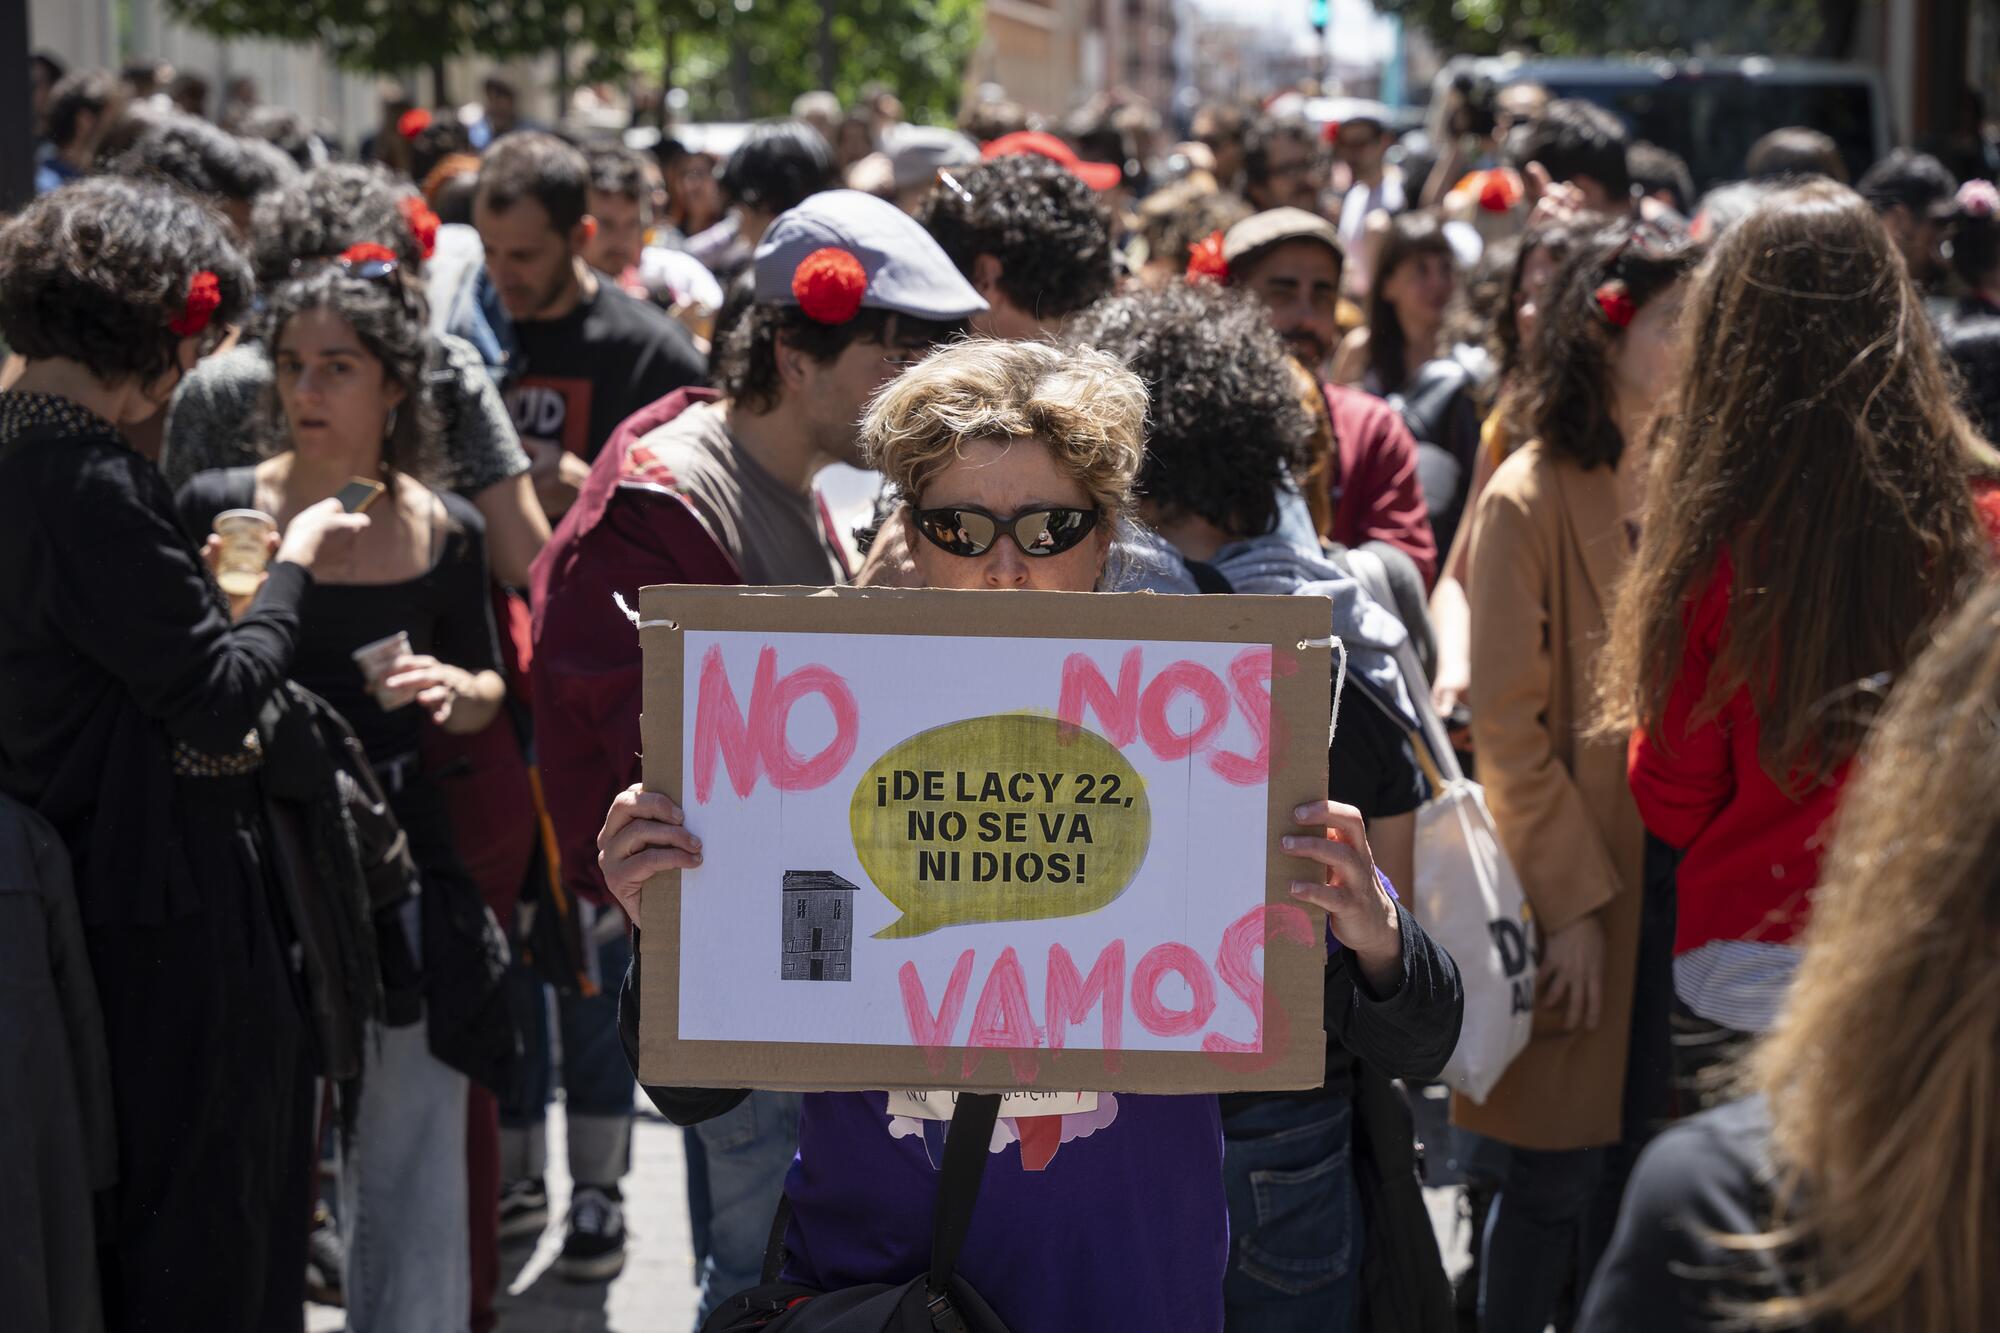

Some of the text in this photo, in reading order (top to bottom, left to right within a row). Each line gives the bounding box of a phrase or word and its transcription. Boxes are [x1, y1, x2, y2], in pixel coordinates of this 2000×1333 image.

[693, 643, 859, 804] NO
[1056, 645, 1298, 787] NOS
[877, 770, 1134, 808] ¡DE LACY 22,
[908, 810, 1093, 844] NO SE VA
[919, 851, 1085, 884] NI DIOS!
[898, 902, 1316, 1084] VAMOS
